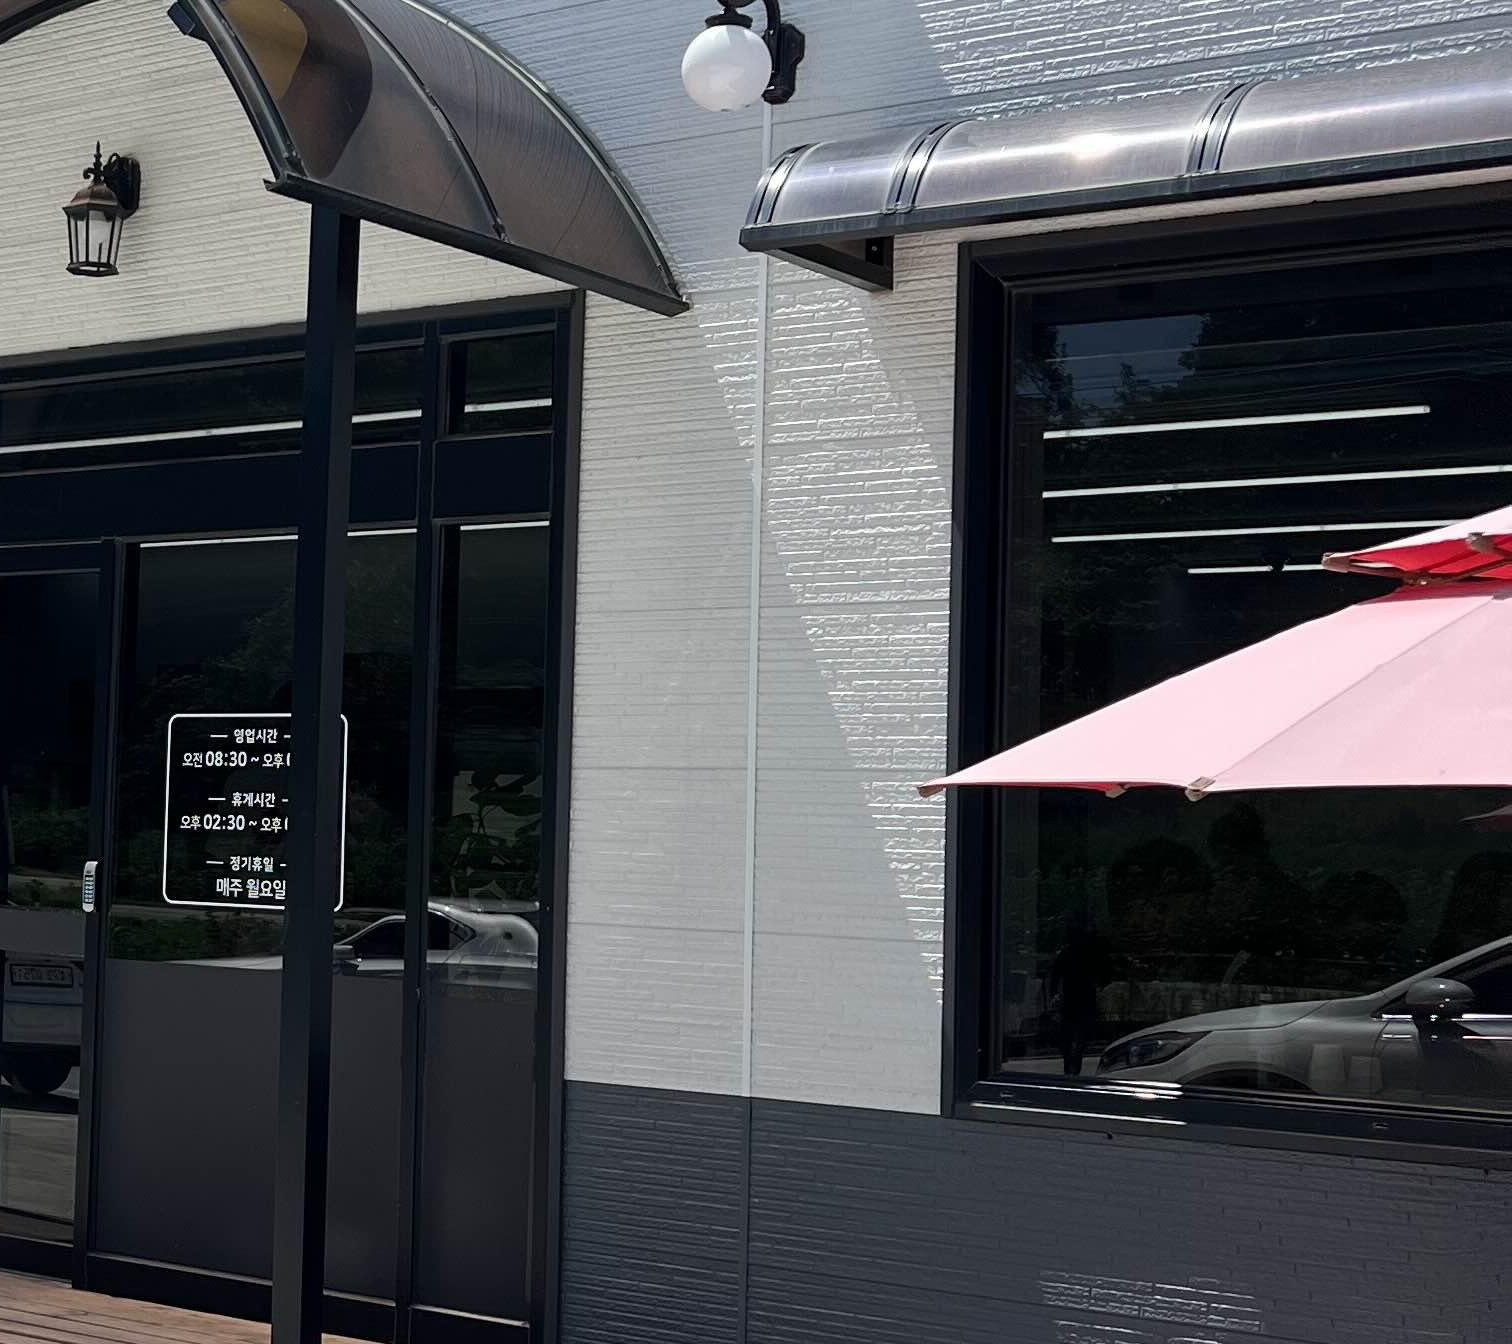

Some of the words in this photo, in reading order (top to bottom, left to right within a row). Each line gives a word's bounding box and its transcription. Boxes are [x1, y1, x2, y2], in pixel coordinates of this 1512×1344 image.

[233, 728, 278, 744] 영업시간
[182, 752, 203, 768] 오전
[205, 751, 247, 767] 08:30
[262, 752, 284, 768] 오후
[231, 792, 276, 808] 휴게시간
[180, 815, 202, 831] 오후
[203, 814, 245, 831] 02:30
[260, 817, 282, 833] 오후
[230, 856, 274, 873] 정기휴일
[216, 878, 243, 897] 매주
[246, 878, 286, 900] 월요일
